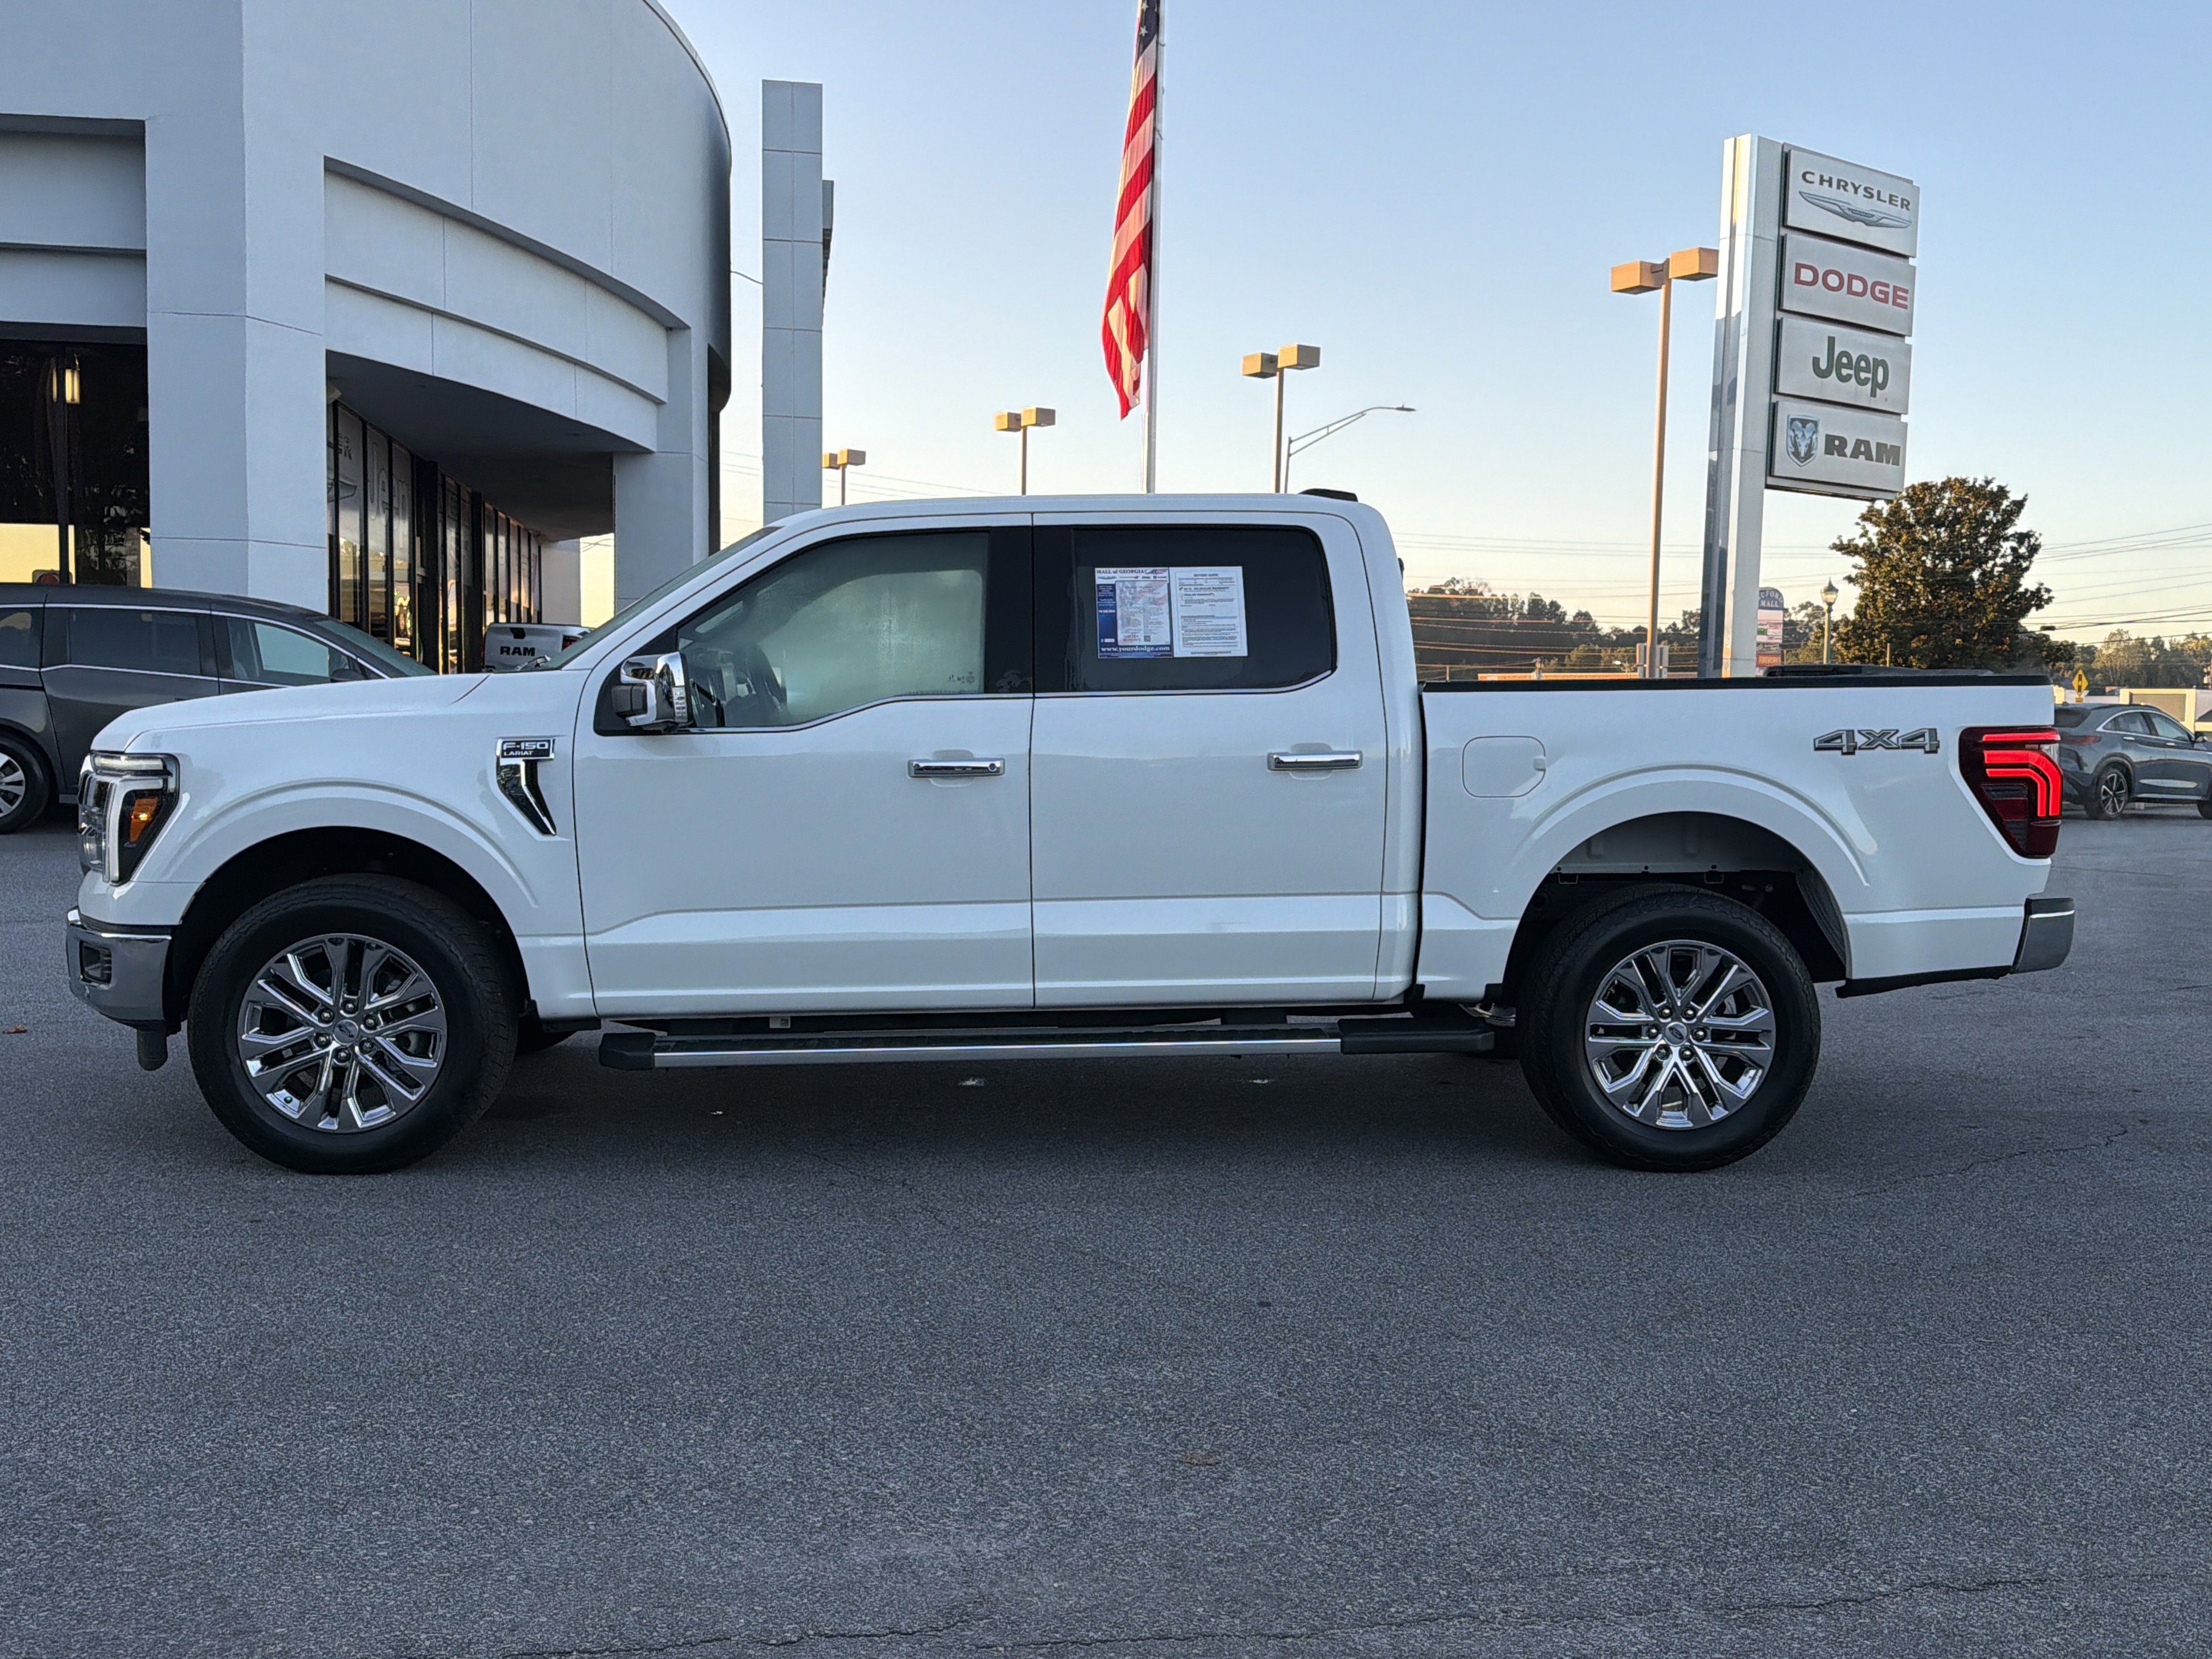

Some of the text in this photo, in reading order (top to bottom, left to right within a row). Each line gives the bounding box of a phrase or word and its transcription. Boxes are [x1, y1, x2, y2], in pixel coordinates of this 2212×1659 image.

[1801, 171, 1911, 211] CHRYSLER
[1794, 262, 1909, 310] DODGE
[1812, 335, 1889, 398] Jeep
[1824, 433, 1901, 466] RAM
[500, 646, 536, 657] RAM
[503, 742, 549, 751] F-150
